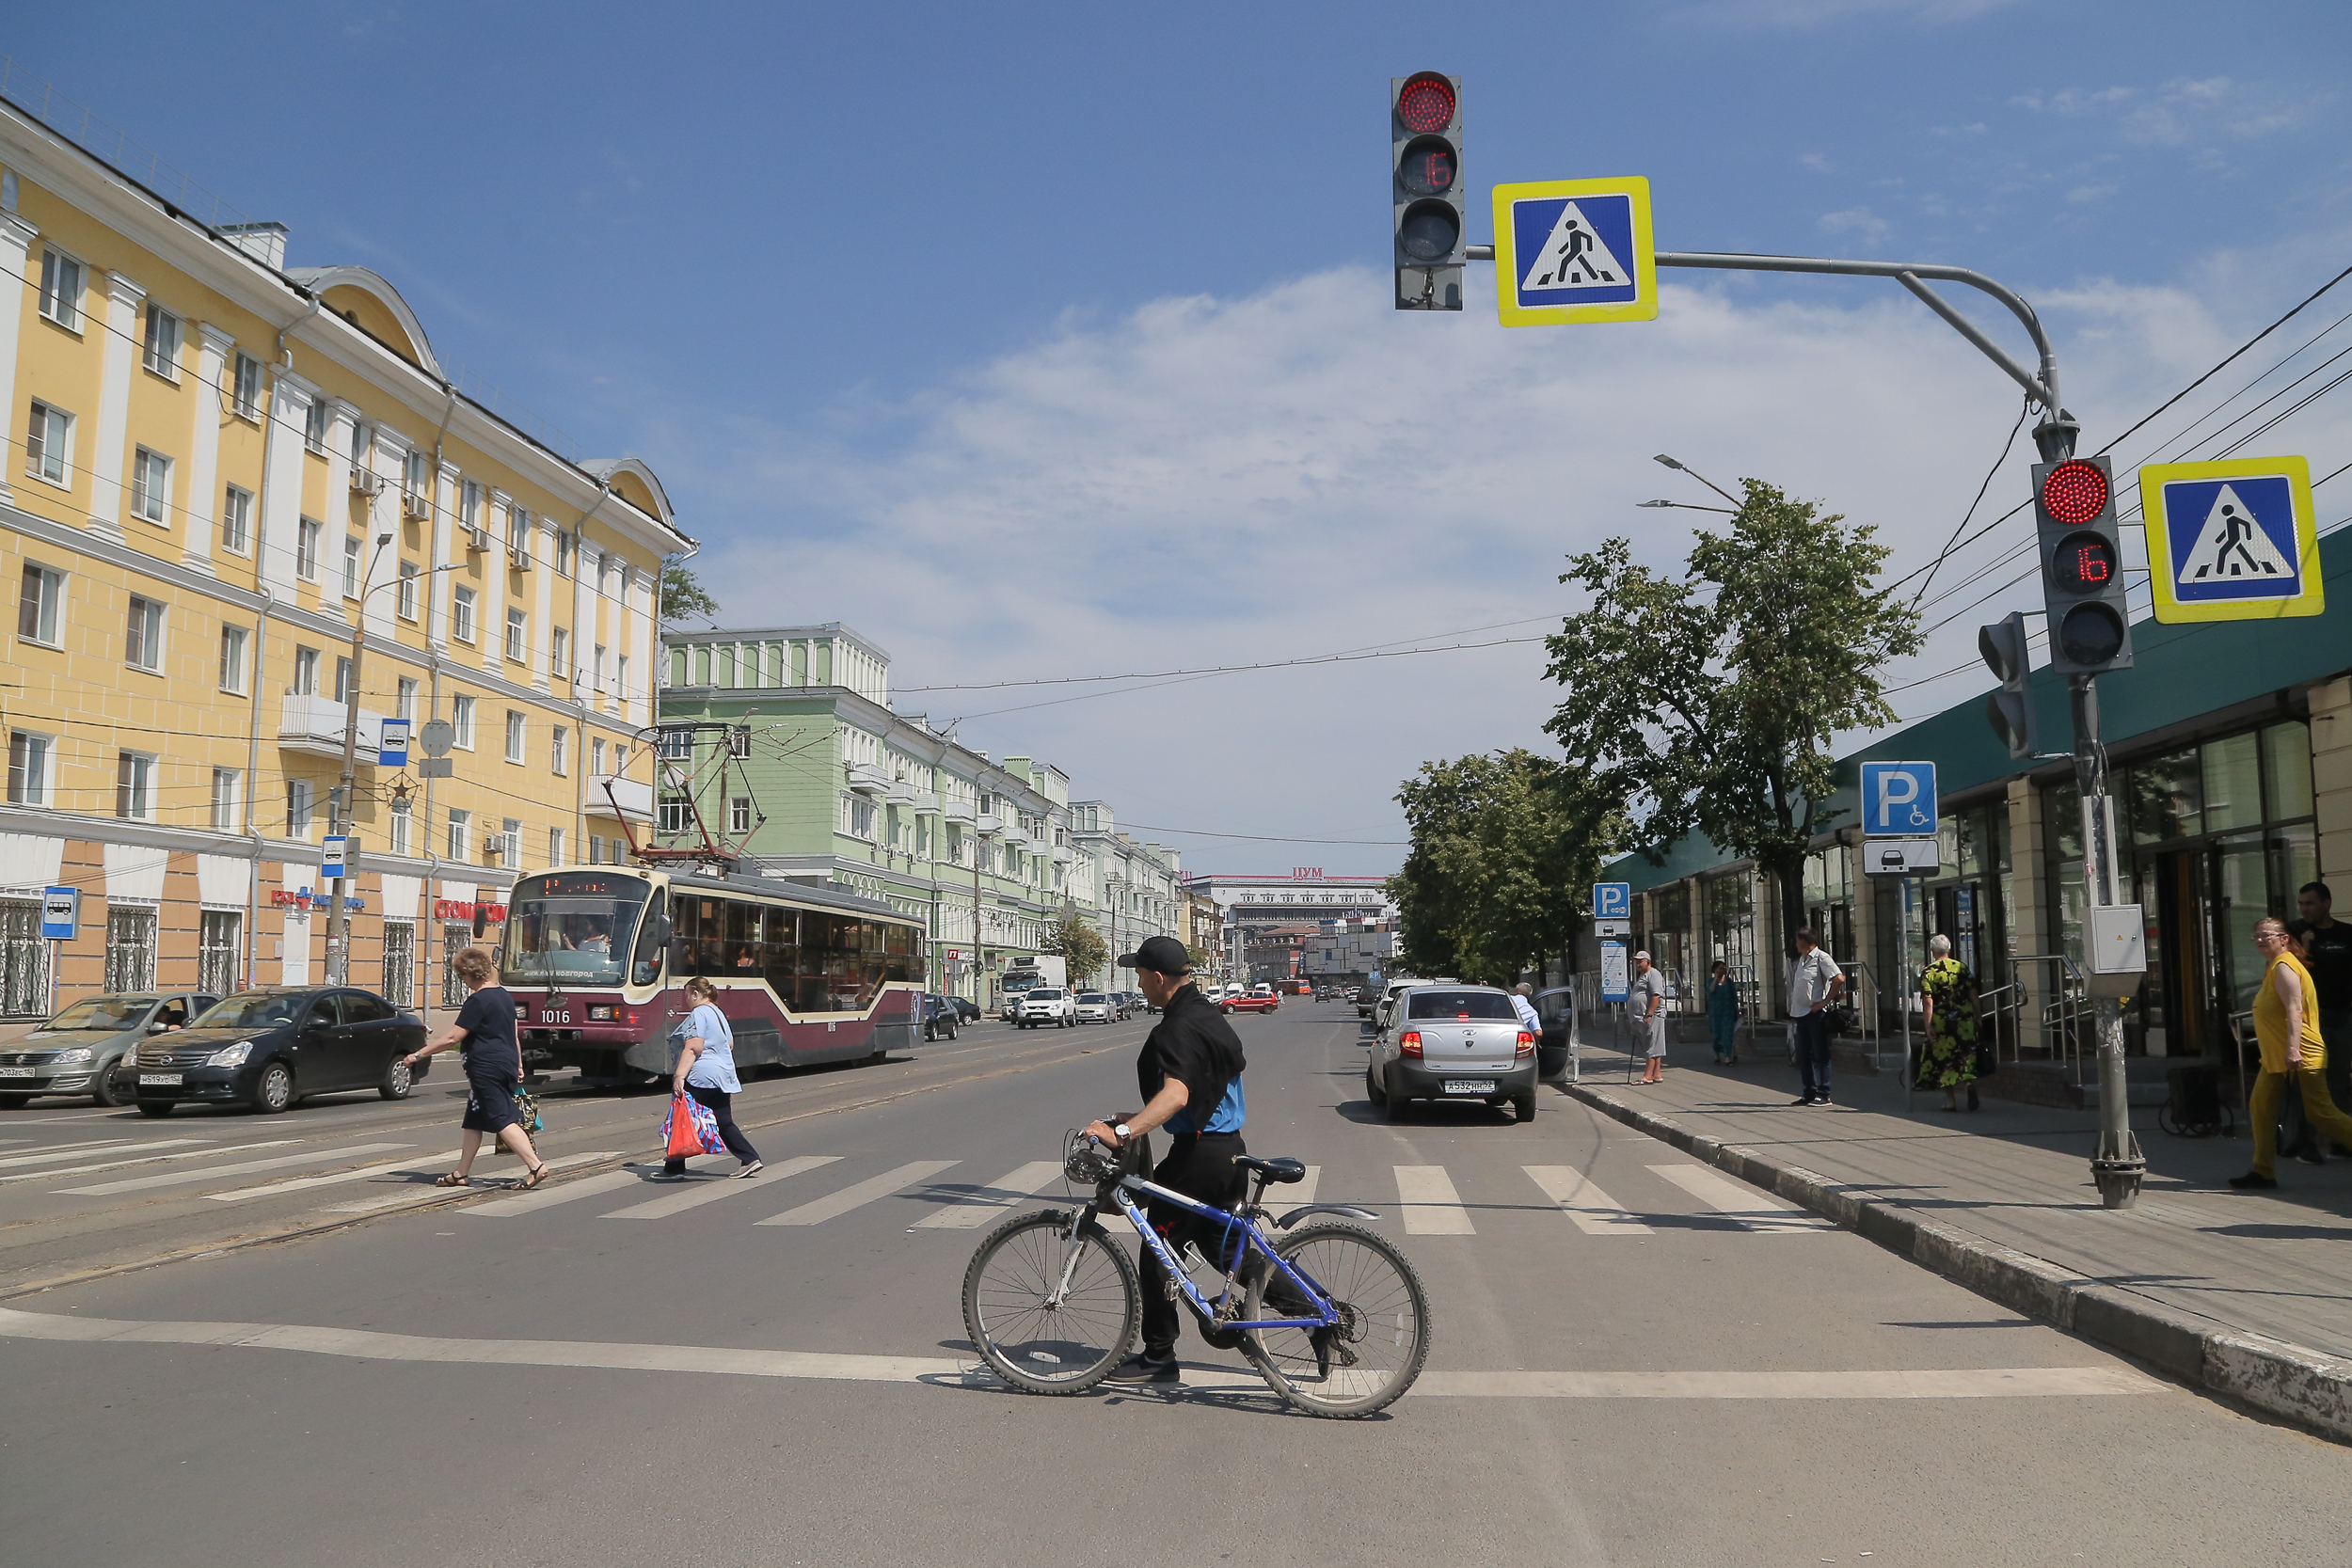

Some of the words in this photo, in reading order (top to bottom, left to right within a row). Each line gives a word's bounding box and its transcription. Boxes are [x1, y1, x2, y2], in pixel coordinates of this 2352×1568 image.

[1426, 152, 1451, 186] 16
[2077, 544, 2108, 581] 16
[1878, 771, 1919, 827] P
[1293, 866, 1323, 880] ЦУМ
[1601, 887, 1622, 914] P
[541, 1009, 570, 1023] 1016
